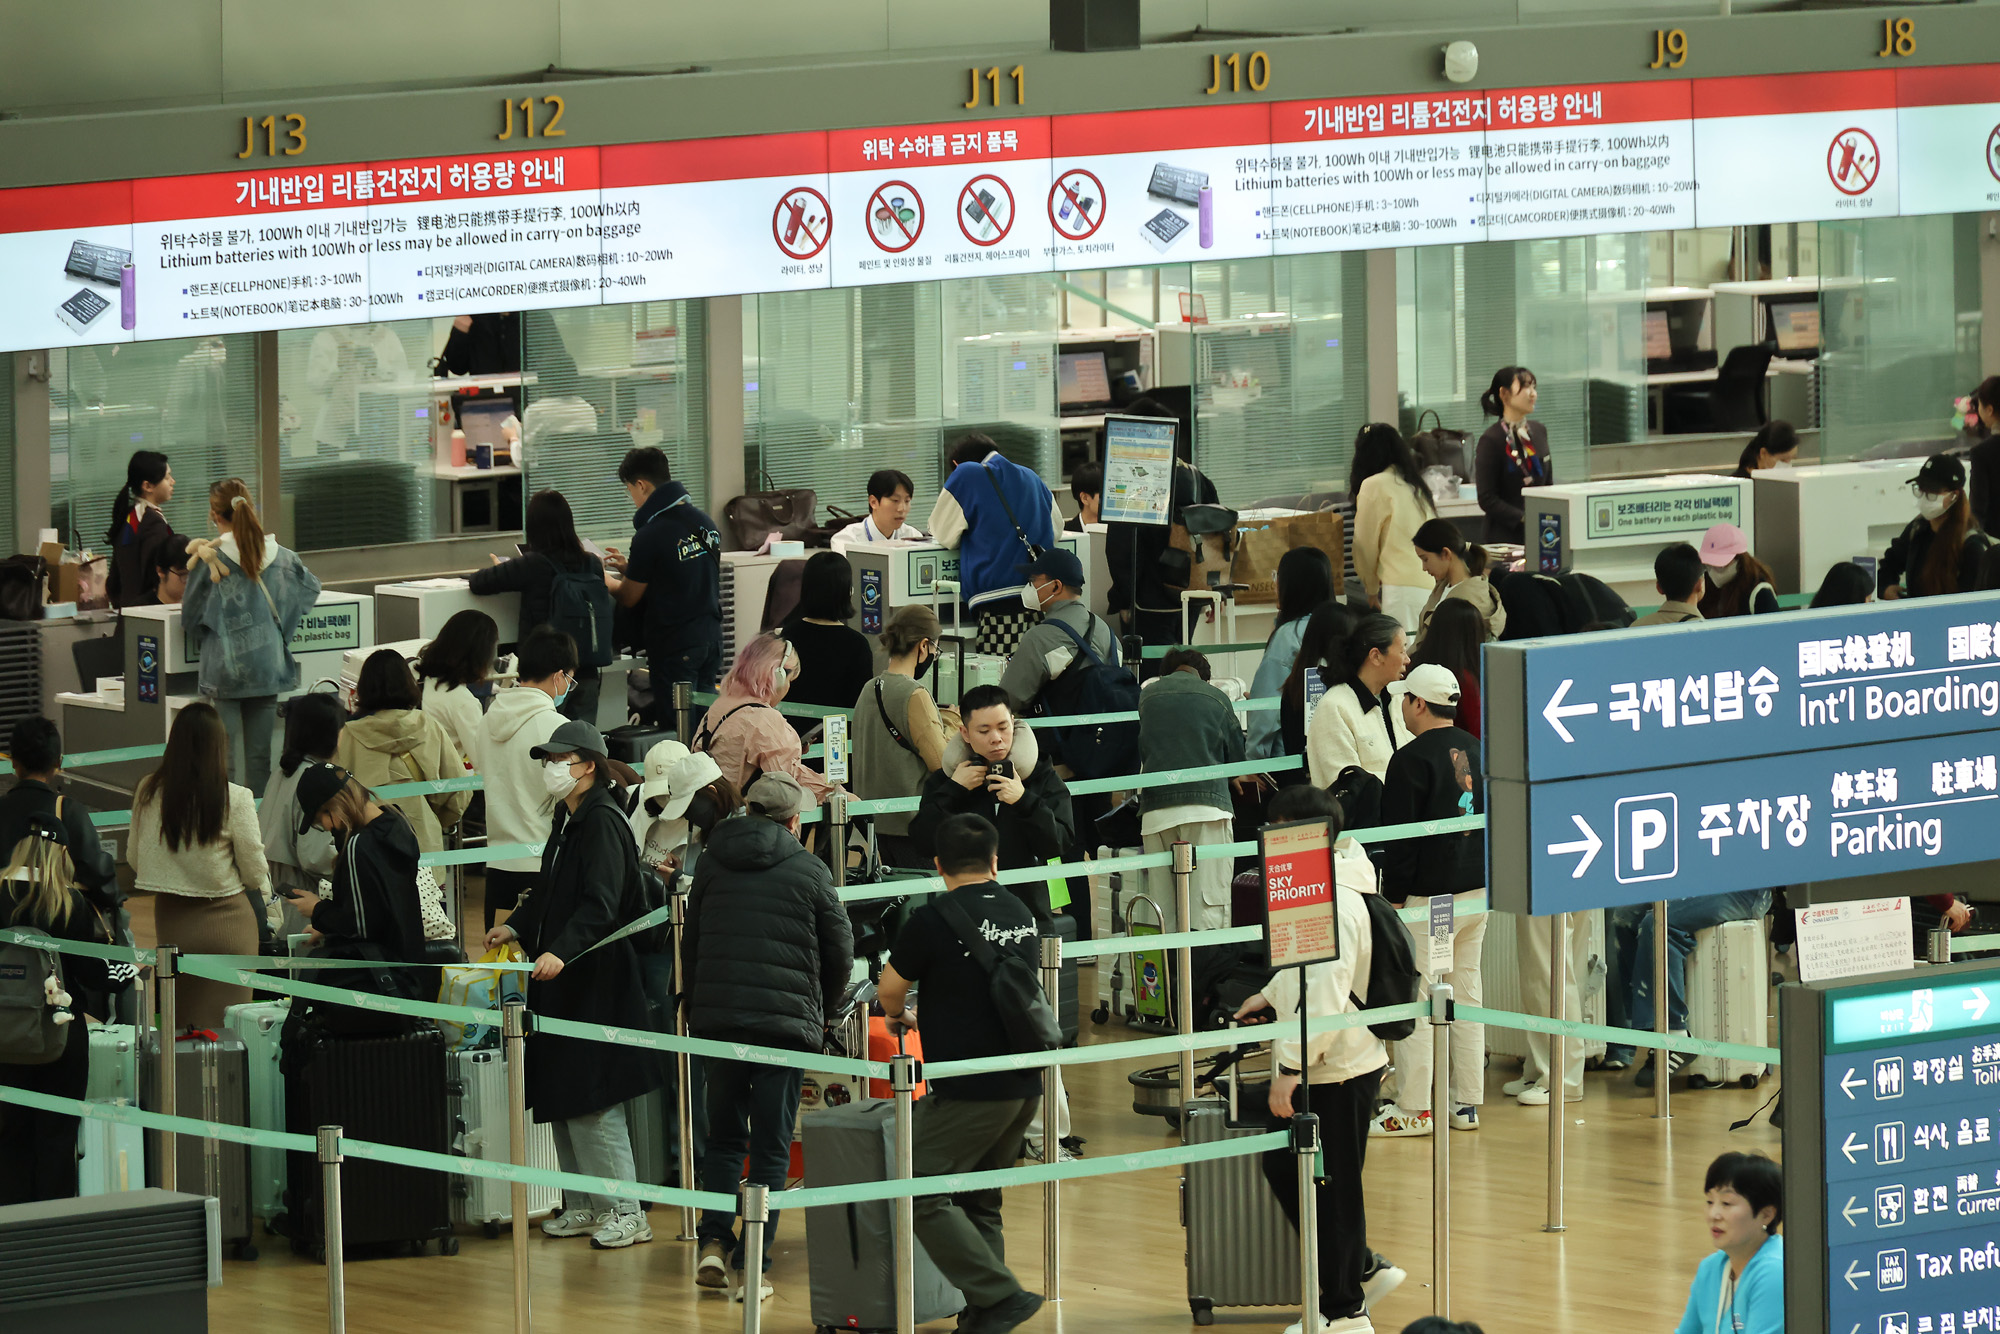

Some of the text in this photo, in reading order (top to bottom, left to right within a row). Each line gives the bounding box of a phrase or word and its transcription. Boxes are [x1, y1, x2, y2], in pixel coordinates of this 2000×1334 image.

[1652, 29, 1687, 68] J9
[1880, 19, 1916, 57] J8
[966, 65, 1024, 108] J11
[1208, 51, 1270, 94] J10
[499, 96, 565, 140] J12
[1305, 91, 1601, 134] 기내반입 리튬건전지 허용량 안내
[240, 114, 306, 158] J13
[863, 131, 1018, 160] 위탁 수하물 금지 품목
[1236, 155, 1292, 175] 위탁수하물
[1326, 153, 1365, 167] 100Wh
[1369, 150, 1389, 165] 이내
[1395, 147, 1459, 163] 기내반입가능
[1236, 156, 1670, 194] Lithium batteries with 100Wh or less may be allowed in carry-on baggage
[237, 157, 563, 207] 기내반입 리튬건전지 허용량 안내
[161, 231, 223, 250] 위탁수하물
[259, 226, 302, 241] 100Wh
[307, 223, 330, 239] 이내
[335, 218, 407, 236] 기내반입가능
[161, 224, 641, 268] Lithium batteries with 100Wh or less may be allowed in carry-on baggage
[1618, 501, 1671, 515] 보조배터리는
[1675, 500, 1691, 510] 각각
[1618, 510, 1732, 526] One battery in each plastic bag
[304, 631, 350, 643] plastic bag
[307, 615, 350, 628] 비닐팩에!
[1610, 666, 1779, 731] 국제선탑승
[1866, 676, 1999, 720] Boarding
[1831, 767, 1898, 809] 停车场
[1698, 794, 1812, 856] 주차장
[1831, 813, 1941, 857] Parking
[1269, 875, 1293, 890] SKY
[1270, 883, 1326, 902] PRIORITY
[1912, 1054, 1963, 1086] 화장실
[1972, 1065, 2000, 1086] Toil
[1914, 1117, 1991, 1150] 식사, 음료
[1881, 1267, 1903, 1285] REFUND
[1885, 1256, 1900, 1268] TAX
[1916, 1253, 1953, 1279] Tax
